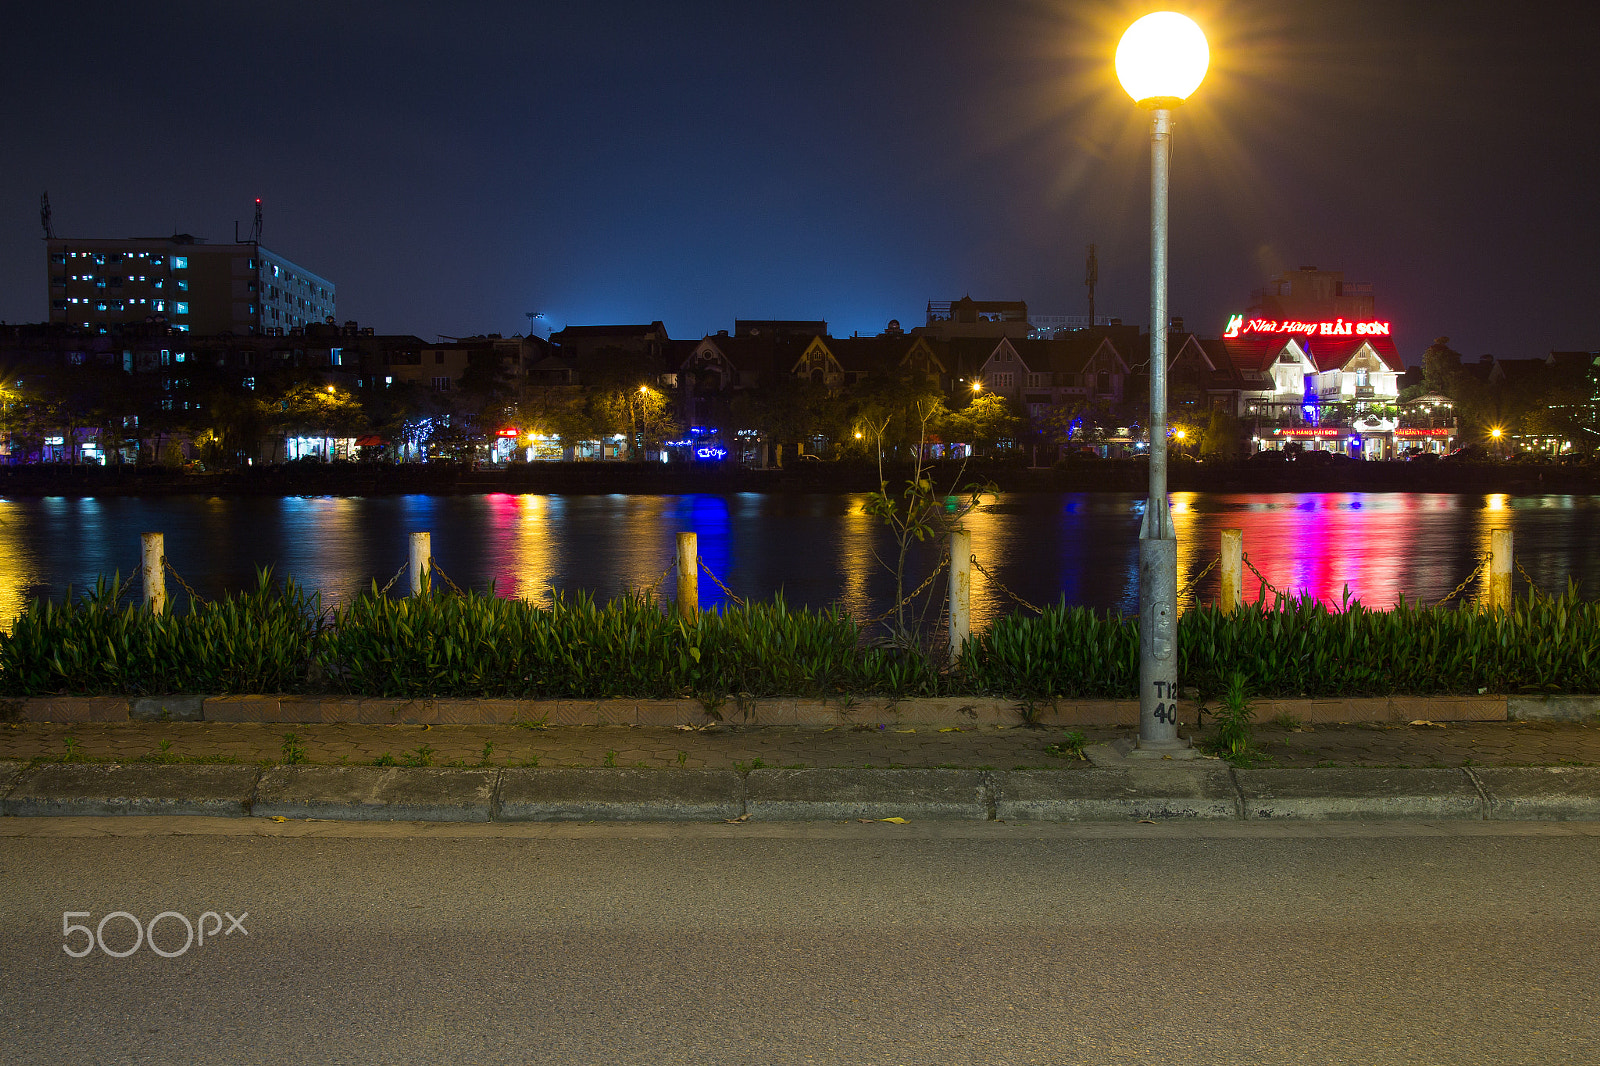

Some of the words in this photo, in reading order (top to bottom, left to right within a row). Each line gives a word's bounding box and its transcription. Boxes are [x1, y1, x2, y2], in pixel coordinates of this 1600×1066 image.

[1243, 319, 1276, 333] Nhà
[1276, 321, 1317, 335] Hàng
[1320, 318, 1352, 334] HẢI
[1356, 320, 1389, 334] SƠN
[1154, 702, 1176, 724] 40
